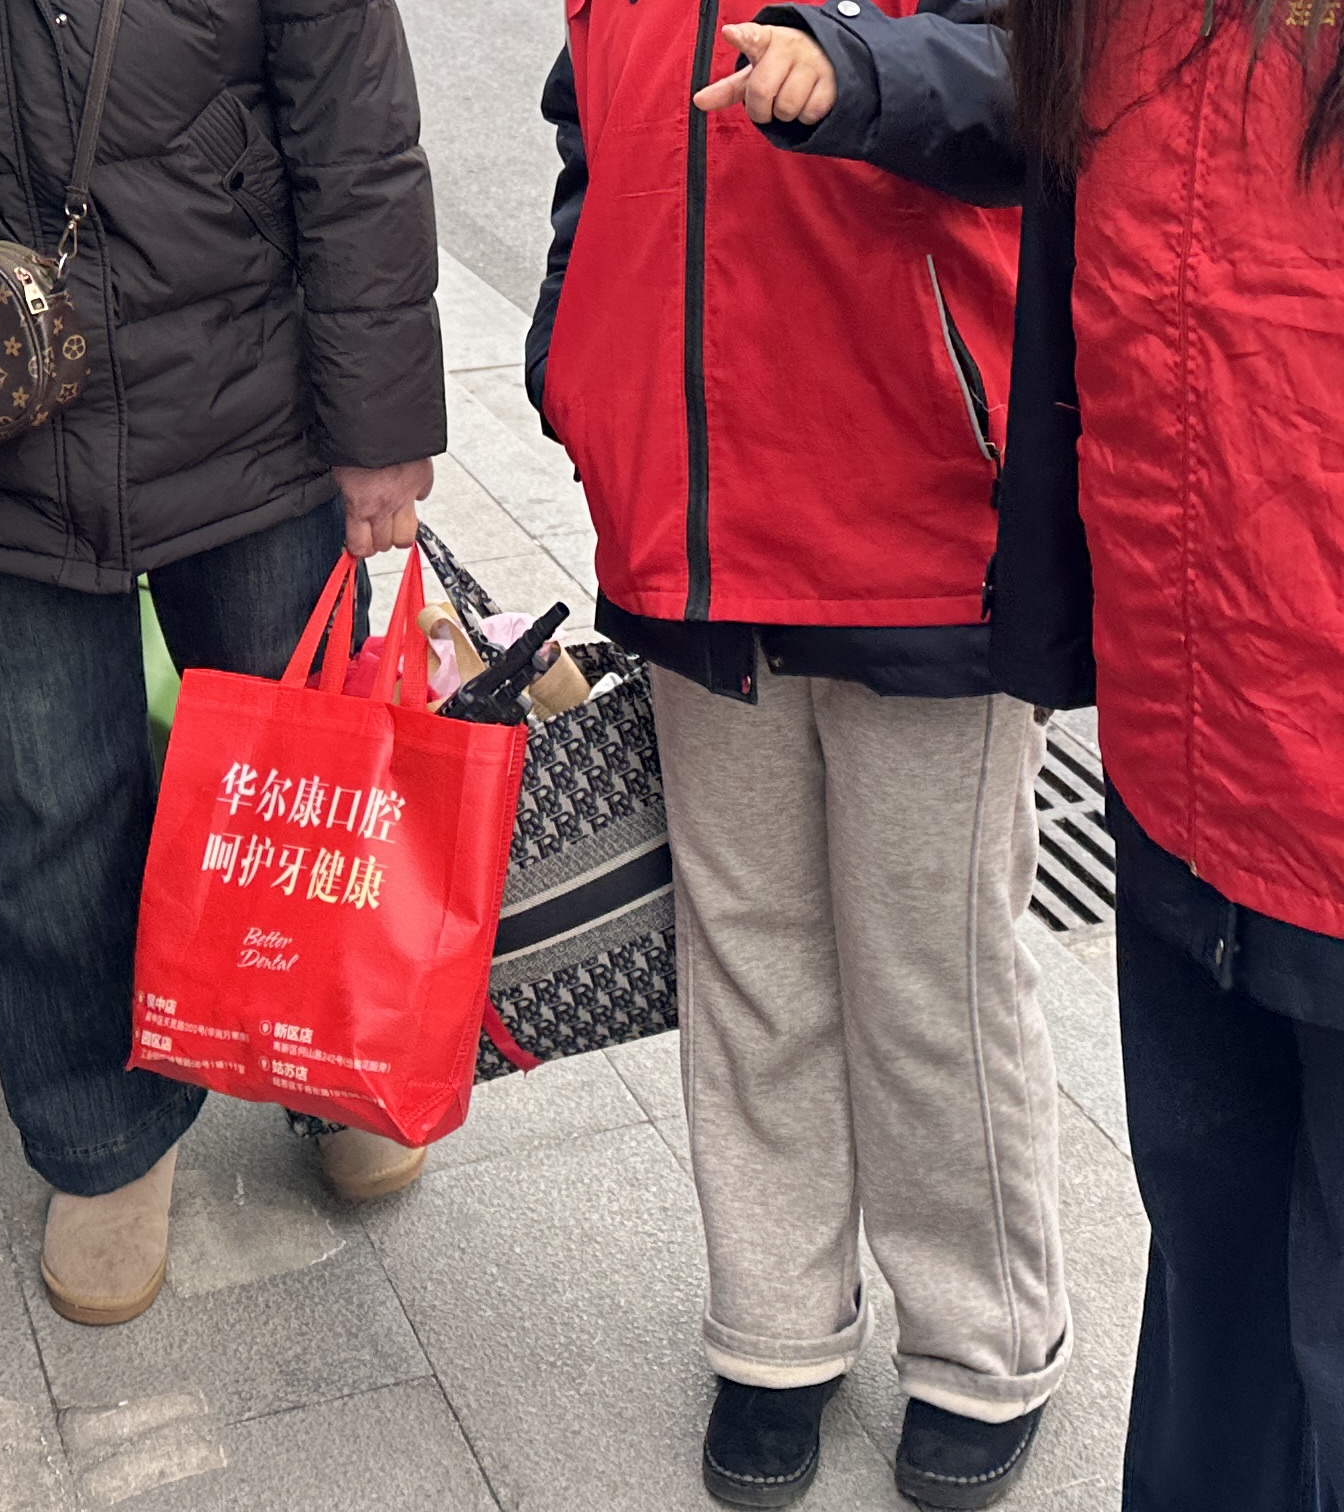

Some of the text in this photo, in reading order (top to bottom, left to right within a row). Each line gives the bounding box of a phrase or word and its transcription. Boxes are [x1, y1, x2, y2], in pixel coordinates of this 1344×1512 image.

[217, 761, 406, 844] 华尔康口腔
[202, 832, 389, 910] 呵护牙健康
[242, 927, 293, 948] Better
[237, 949, 299, 972] Dental
[274, 1022, 314, 1045] 新区店
[272, 1059, 308, 1082] 姑苏店
